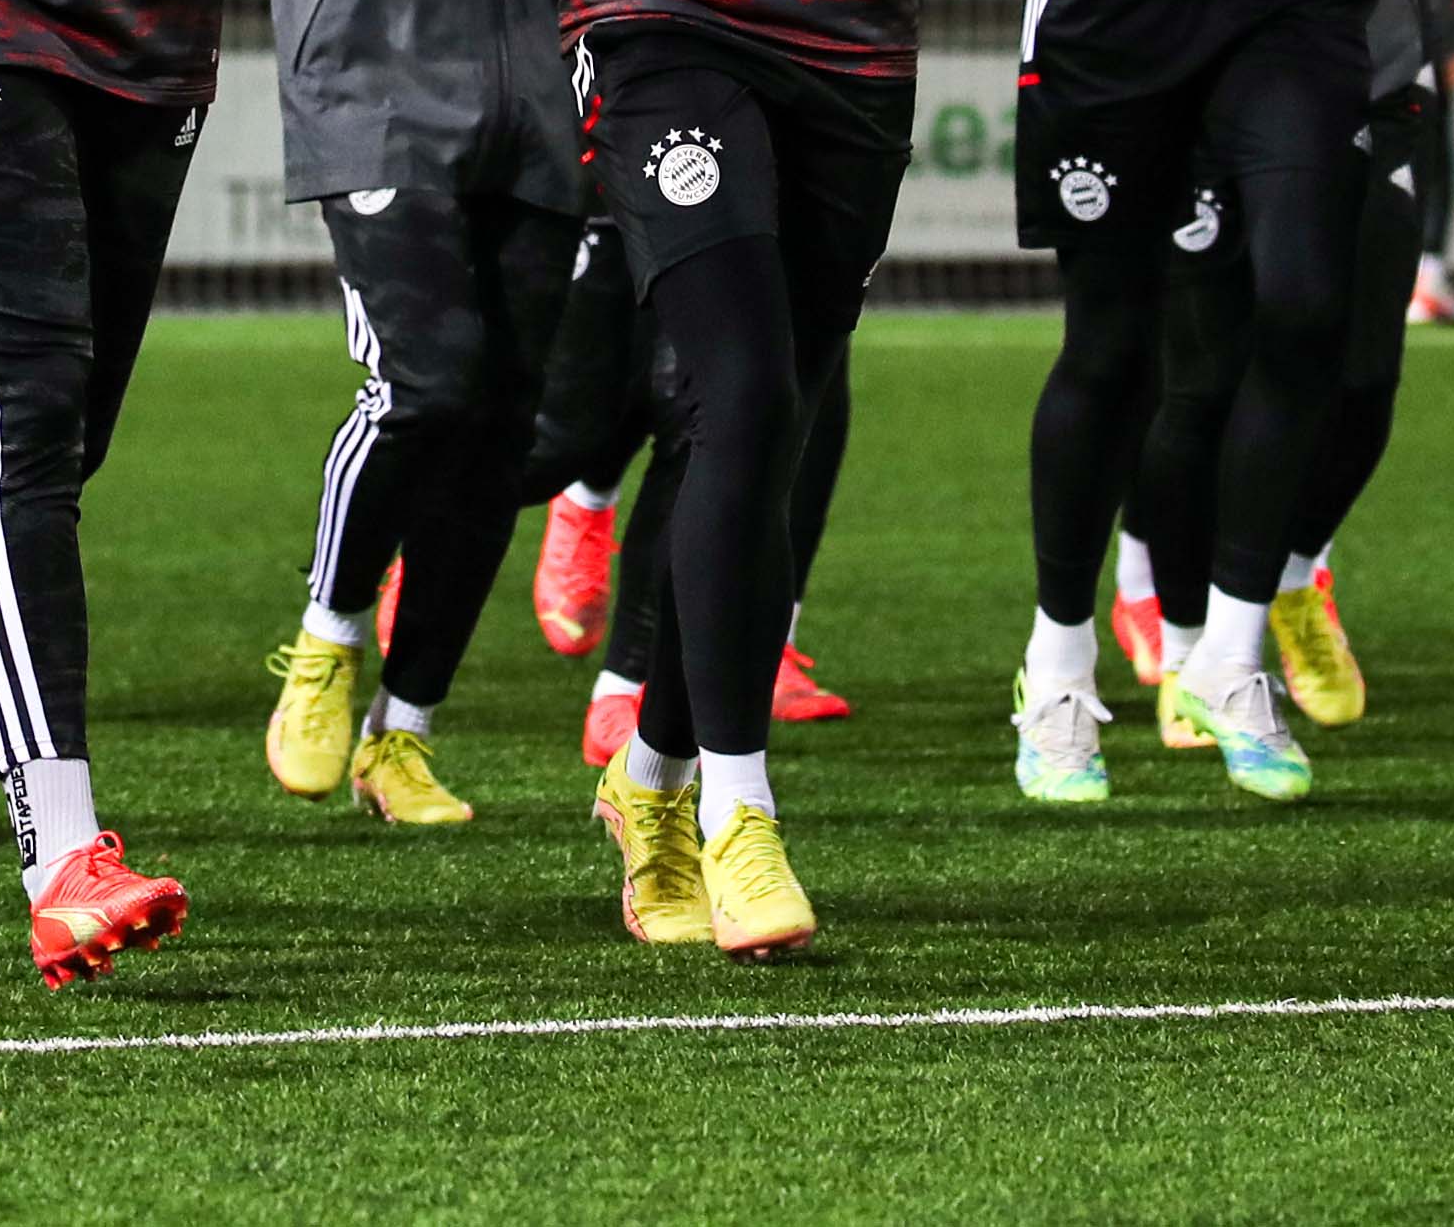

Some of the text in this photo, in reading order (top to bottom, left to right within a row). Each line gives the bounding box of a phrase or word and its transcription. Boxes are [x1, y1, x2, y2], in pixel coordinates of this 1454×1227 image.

[663, 149, 710, 179] FC BAYERN
[10, 759, 32, 831] TAPEDE
